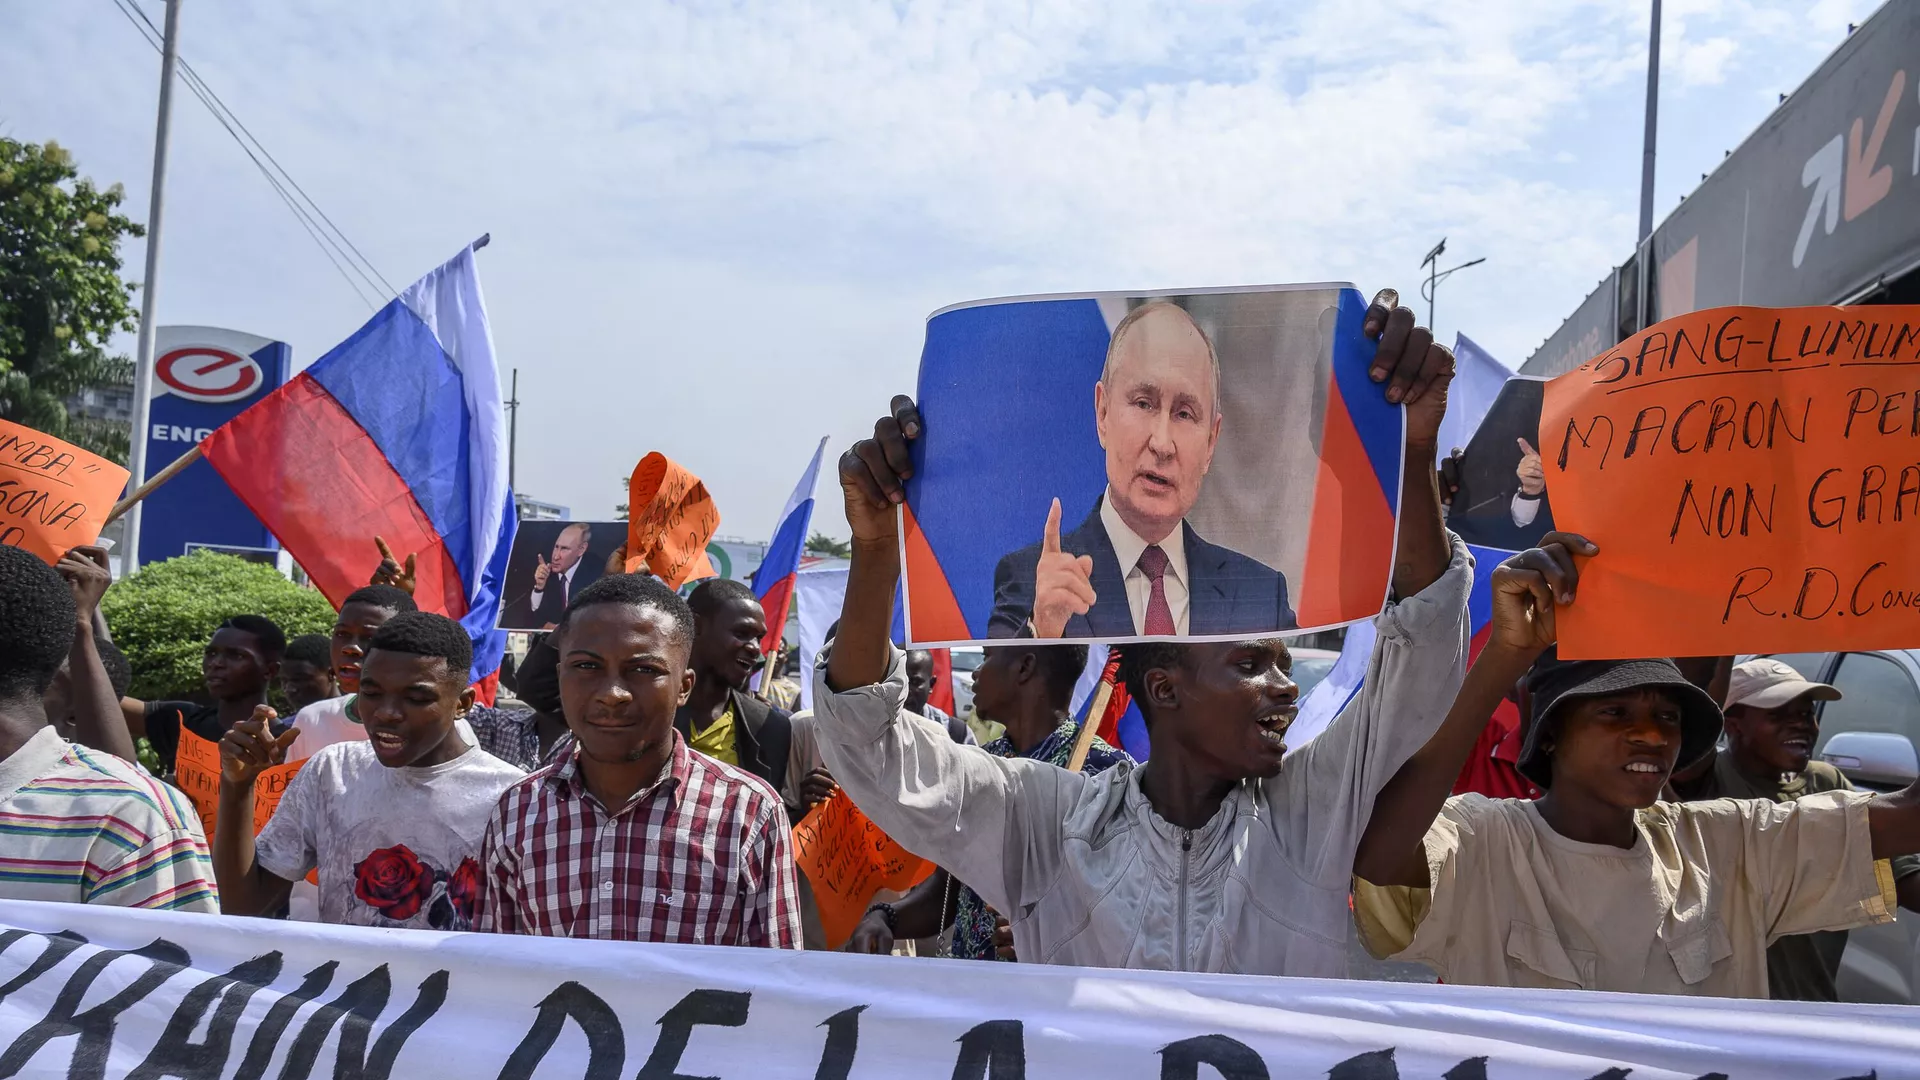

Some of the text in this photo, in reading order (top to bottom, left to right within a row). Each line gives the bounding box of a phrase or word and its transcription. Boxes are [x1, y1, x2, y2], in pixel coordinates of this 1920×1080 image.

[1557, 396, 1812, 472] MACRON
[1671, 462, 1920, 544] NON GRA
[500, 980, 752, 1080] DE
